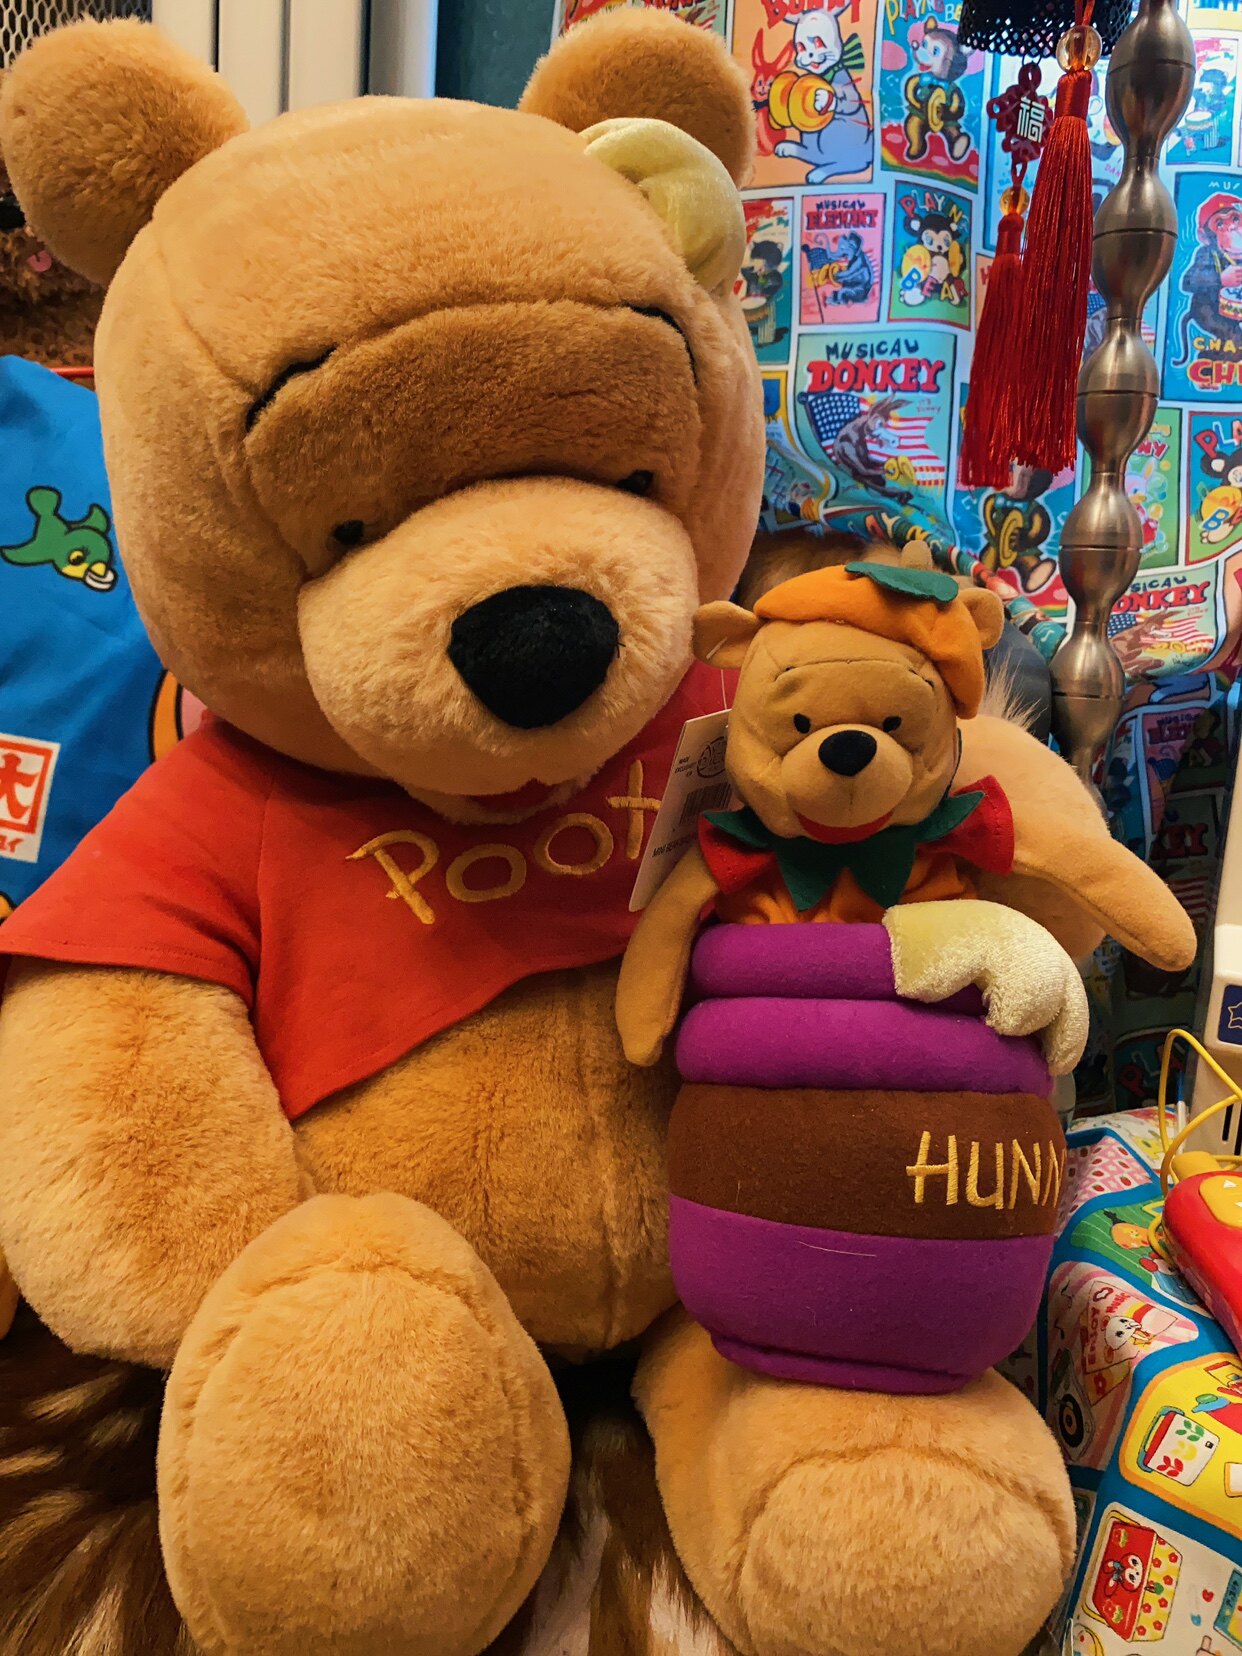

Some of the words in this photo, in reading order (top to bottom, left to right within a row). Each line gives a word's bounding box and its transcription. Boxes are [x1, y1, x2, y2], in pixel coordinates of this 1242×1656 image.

[1017, 96, 1045, 142] 福
[807, 357, 945, 393] DONKEY
[1111, 581, 1211, 614] ONKEY
[906, 1130, 1067, 1210] HUNN
